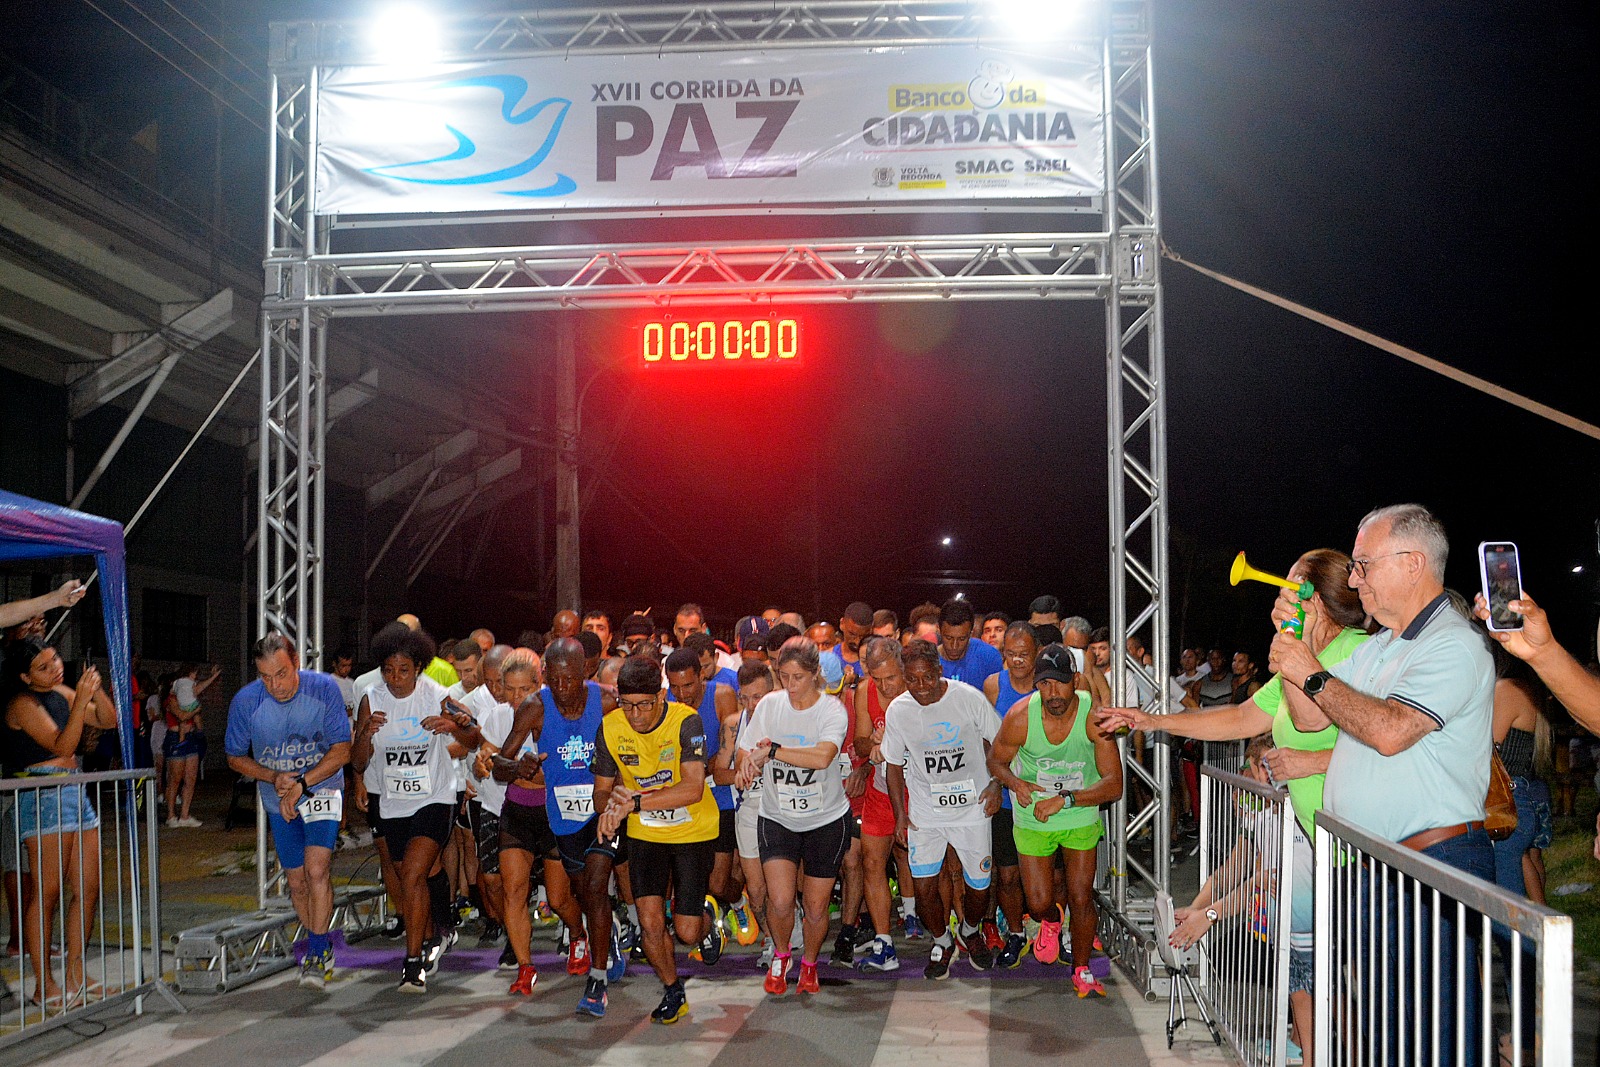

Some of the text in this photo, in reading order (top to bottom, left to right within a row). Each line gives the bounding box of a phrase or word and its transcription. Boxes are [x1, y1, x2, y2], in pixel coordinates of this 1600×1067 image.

[591, 77, 805, 102] XVII CORRIDA DA
[895, 84, 1037, 107] Banco da
[862, 112, 1076, 146] CIDADANIA
[596, 101, 800, 182] PAZ
[901, 167, 929, 175] VOLTA
[955, 159, 1014, 174] SMAC
[1024, 159, 1071, 173] SMEL
[901, 172, 942, 181] REDONDA
[643, 319, 797, 361] 00:00:00
[262, 742, 316, 757] Atleta
[557, 742, 594, 754] CORAÇÃO
[386, 750, 427, 766] PAZ
[925, 753, 965, 774] PAZ
[773, 767, 816, 786] PAZ
[394, 780, 421, 792] 765
[305, 799, 331, 813] 181
[564, 799, 591, 812] 217
[789, 798, 808, 810] 13
[939, 793, 968, 806] 606
